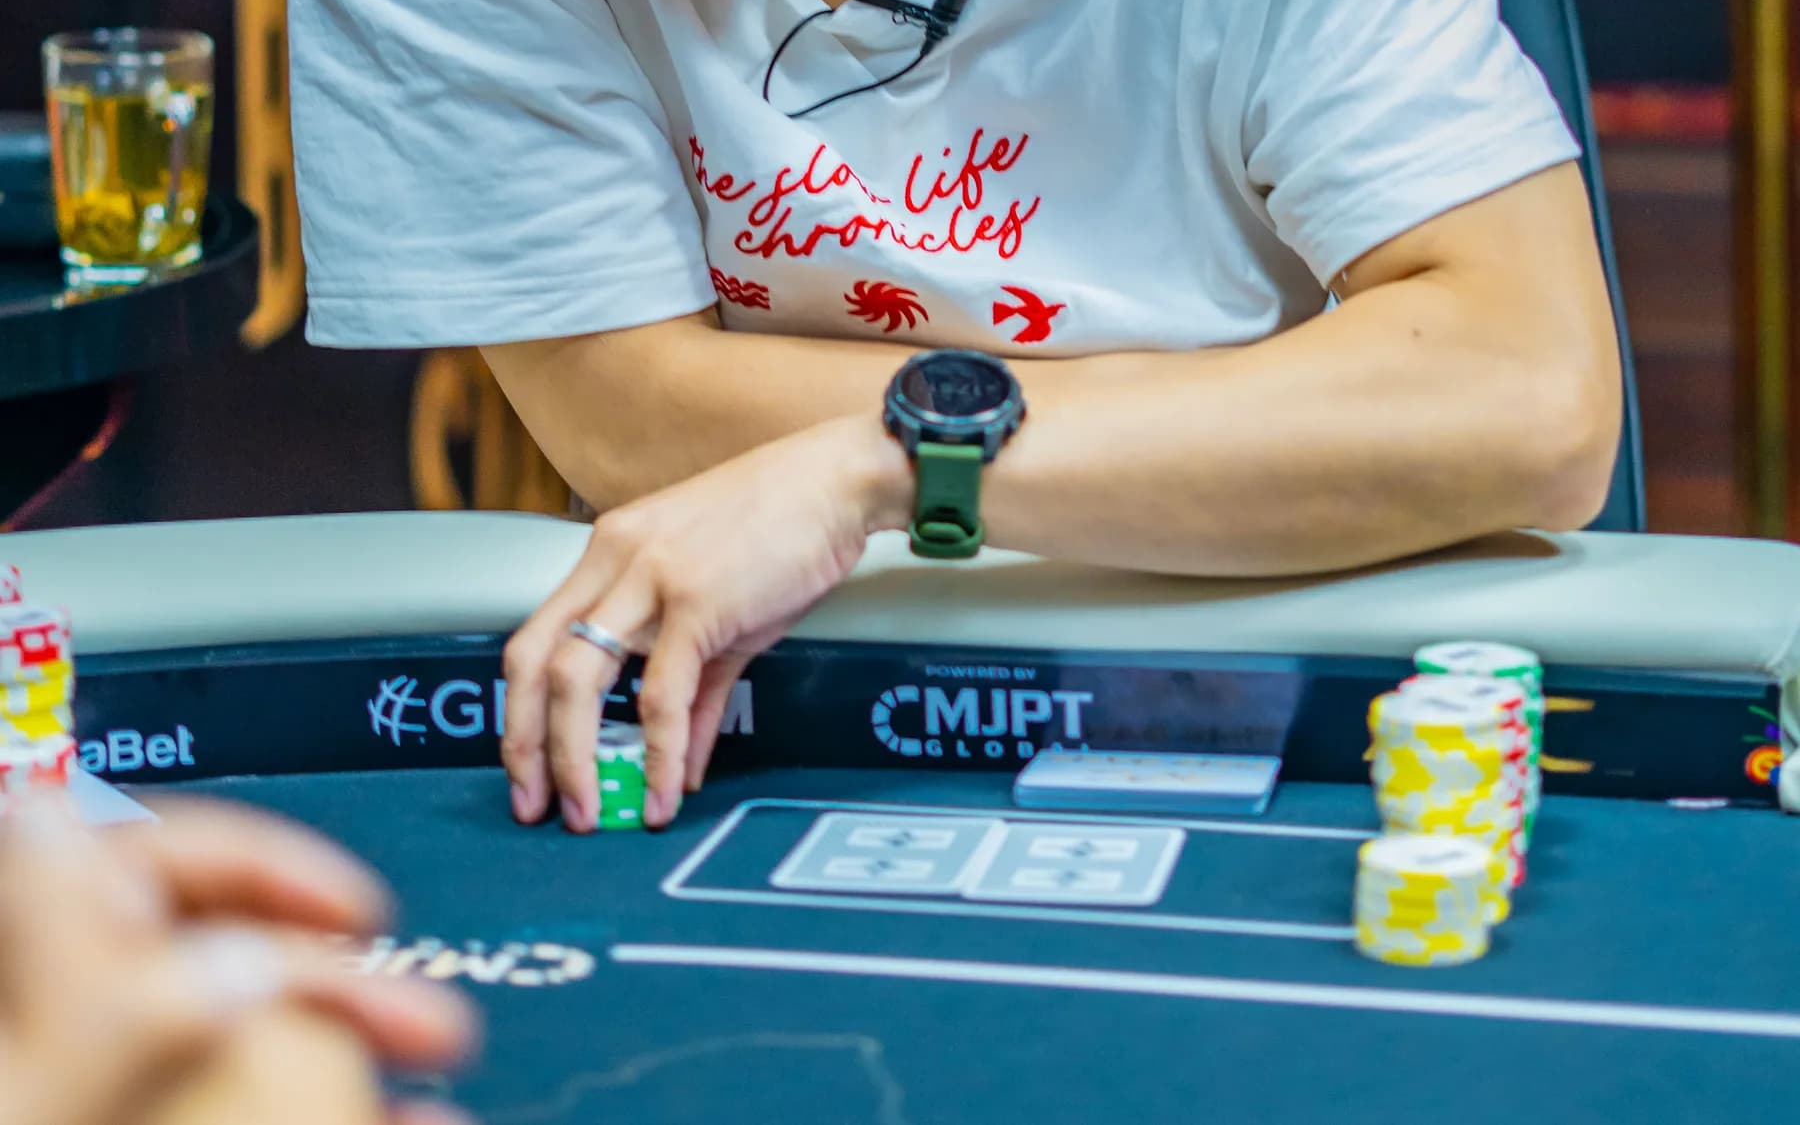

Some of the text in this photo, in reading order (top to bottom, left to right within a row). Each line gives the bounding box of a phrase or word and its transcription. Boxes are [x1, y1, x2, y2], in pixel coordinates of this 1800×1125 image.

[748, 143, 891, 227] slo
[904, 127, 1030, 214] life
[734, 195, 1042, 259] chronicles
[925, 664, 1037, 680] POWERED BY
[79, 724, 196, 773] aBet
